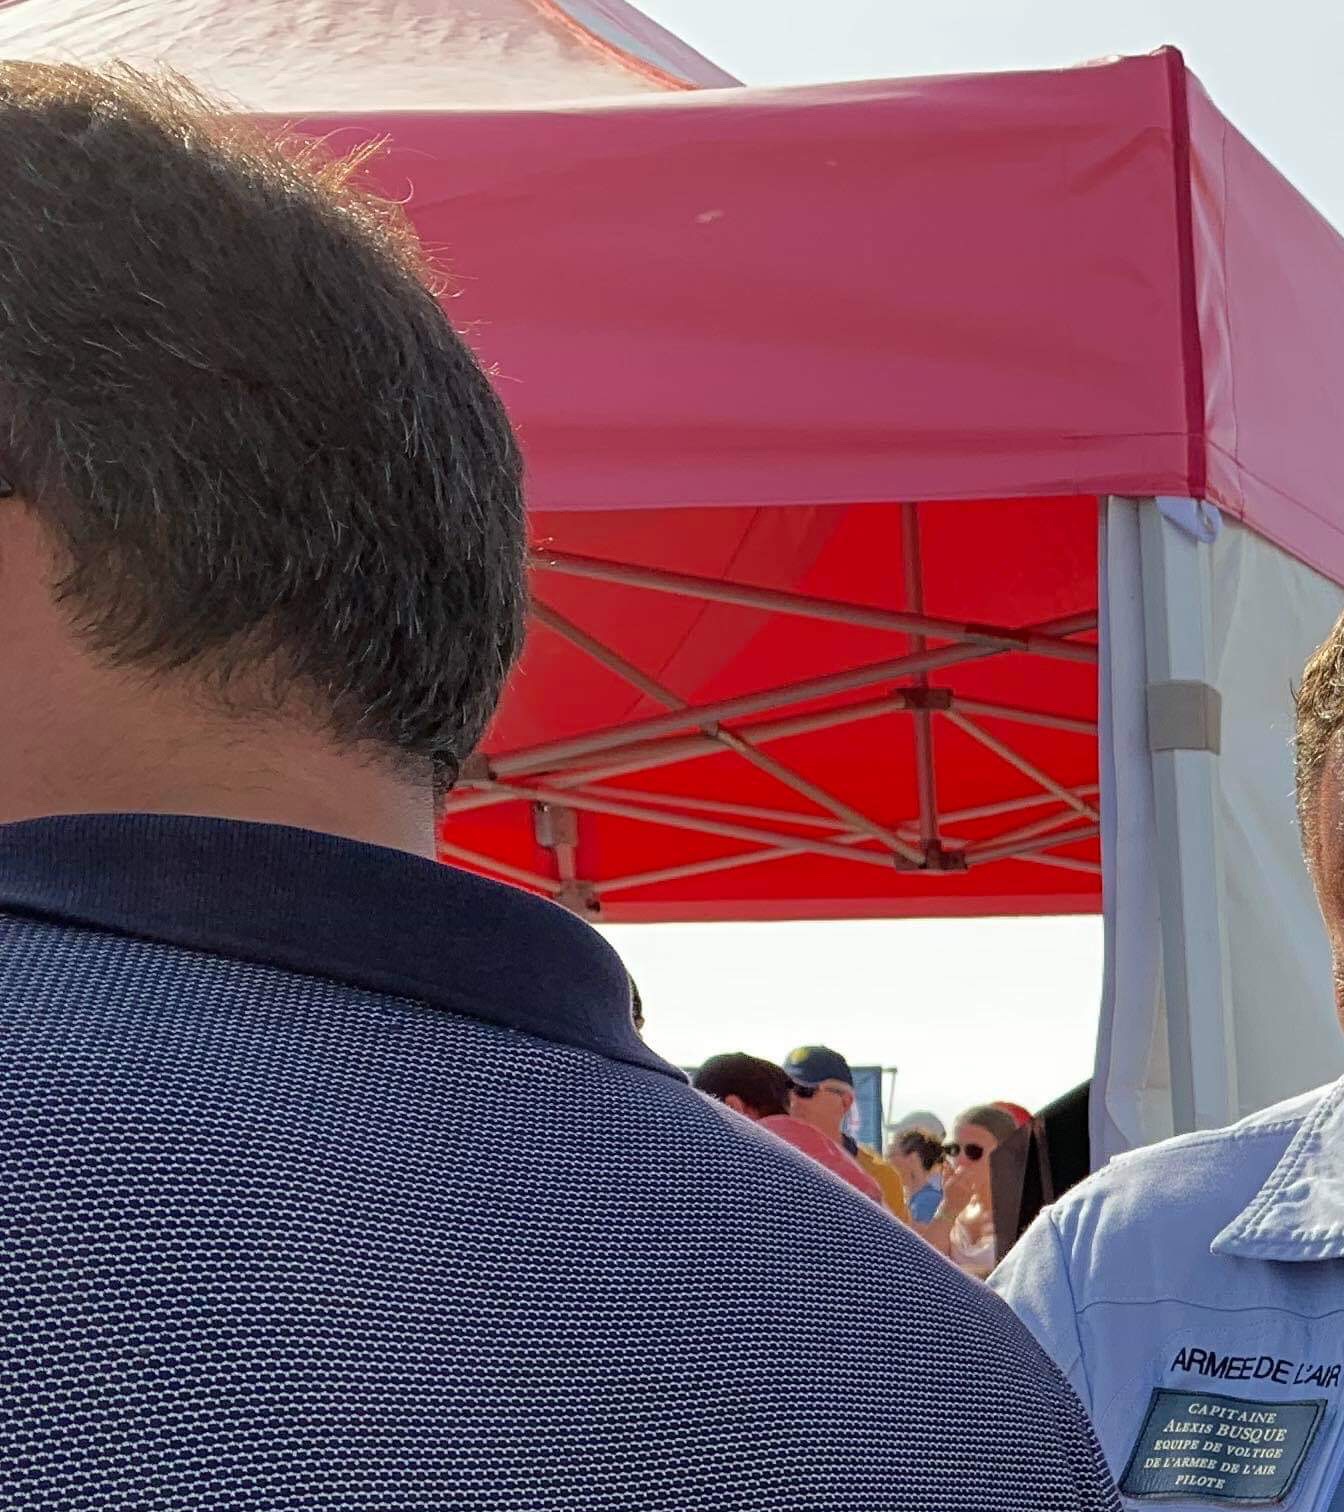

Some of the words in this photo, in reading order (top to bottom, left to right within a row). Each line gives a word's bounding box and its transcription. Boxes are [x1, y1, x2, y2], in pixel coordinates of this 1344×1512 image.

[1170, 1347, 1257, 1380] ARMEE
[1254, 1356, 1292, 1384] DE
[1294, 1362, 1342, 1389] L'AIR
[1188, 1403, 1277, 1424] CAPITAINE
[1216, 1424, 1287, 1443] BUSQUE
[1154, 1439, 1200, 1452] EQUIPE
[1203, 1441, 1221, 1453] DE
[1226, 1445, 1284, 1459] VOLTIGE
[1144, 1458, 1161, 1469] DE
[1164, 1457, 1218, 1470] L'ARMEE
[1221, 1462, 1240, 1474] DE
[1242, 1463, 1276, 1475] L'AIR
[1175, 1475, 1226, 1490] PILOTE
